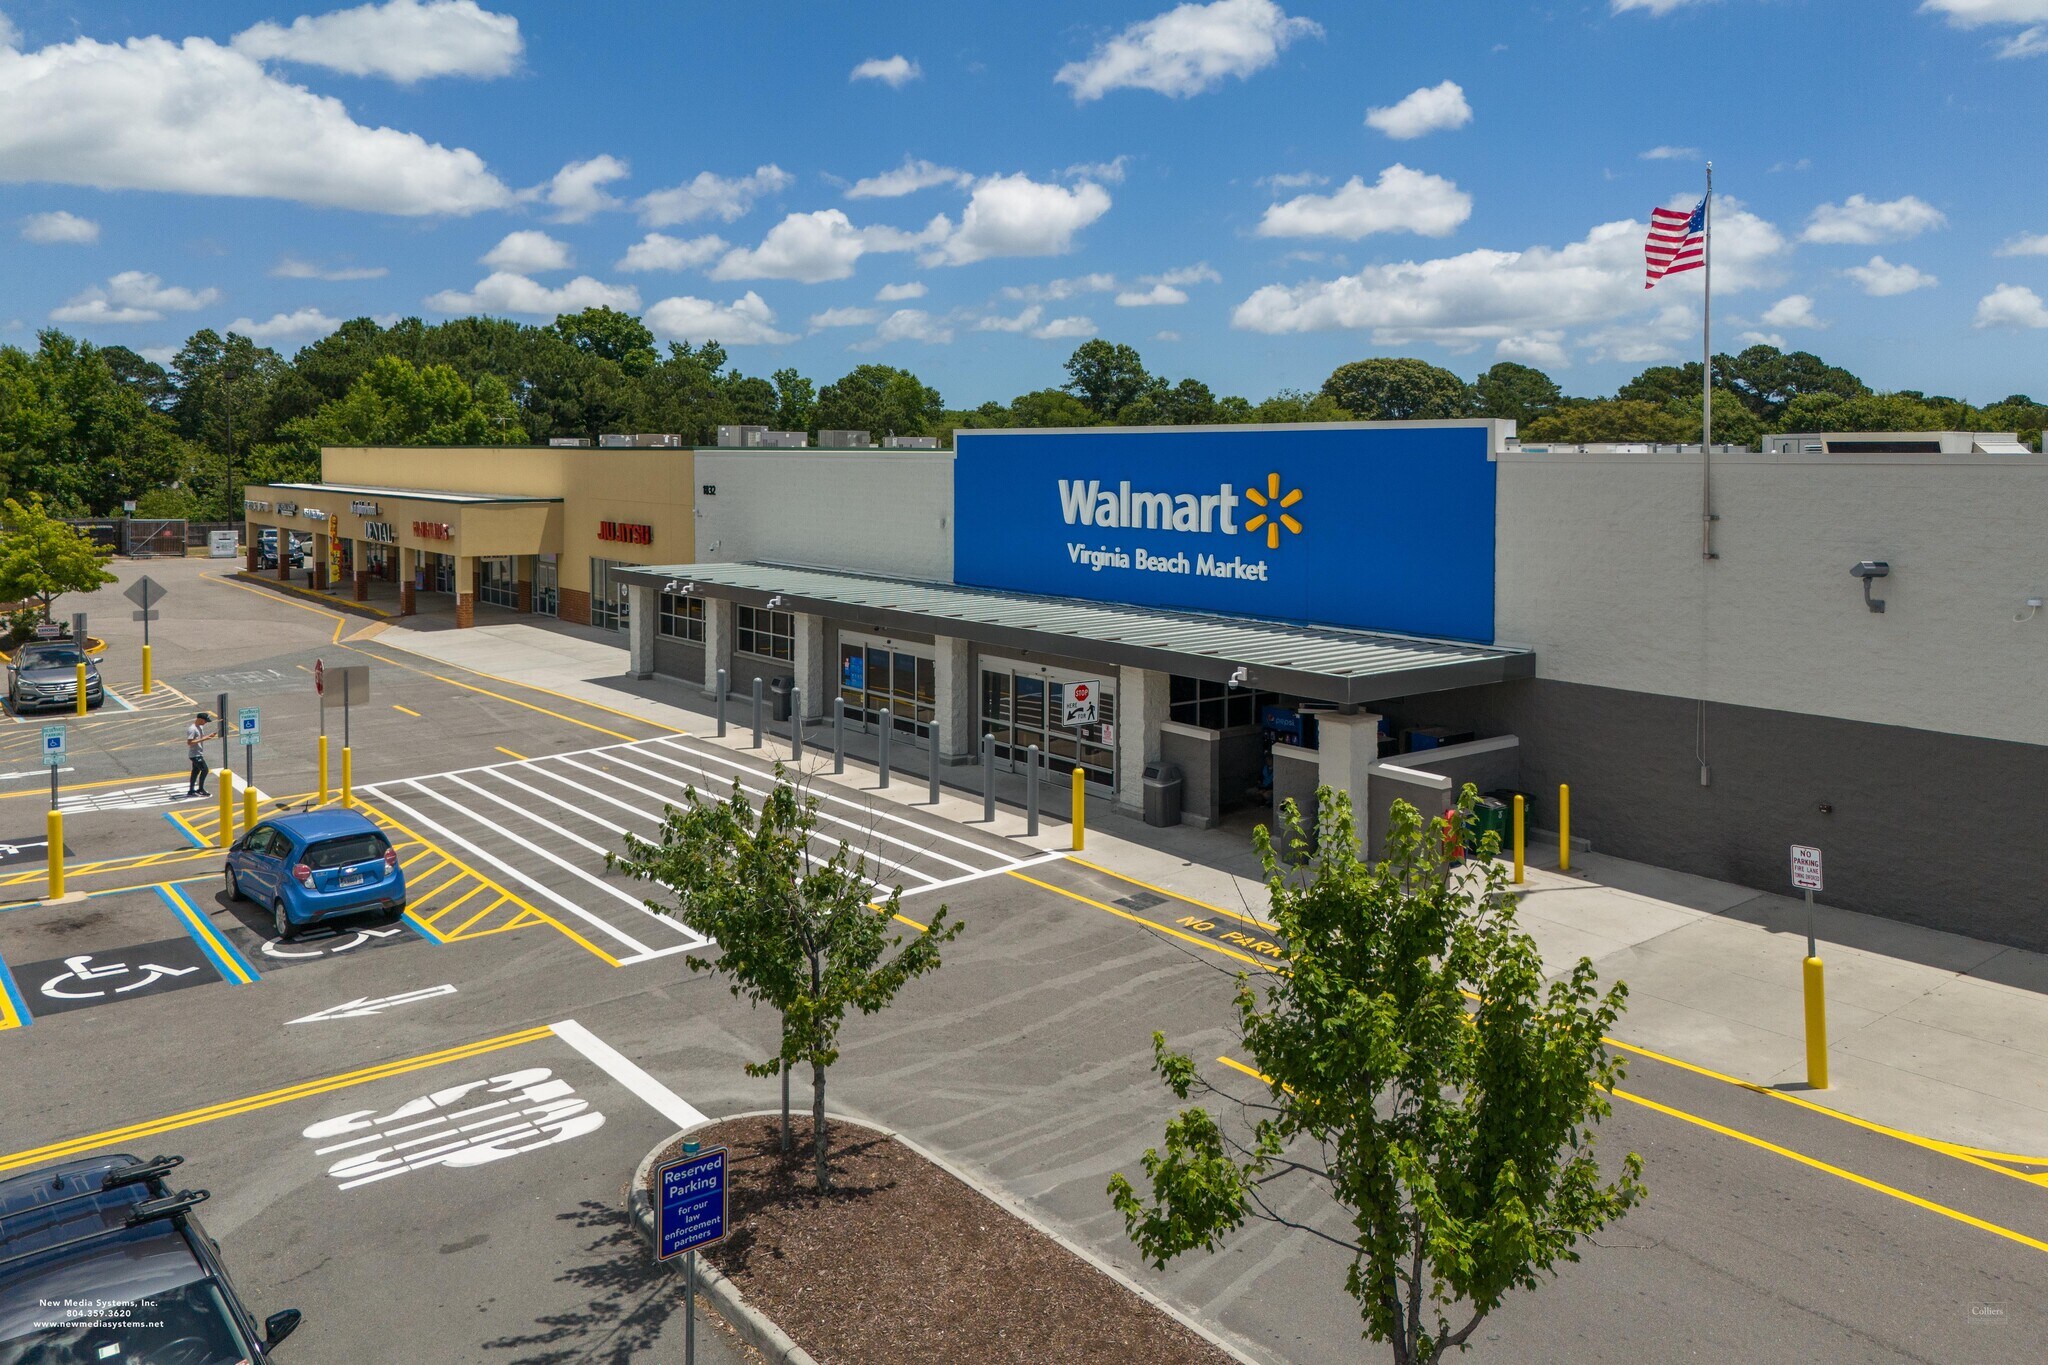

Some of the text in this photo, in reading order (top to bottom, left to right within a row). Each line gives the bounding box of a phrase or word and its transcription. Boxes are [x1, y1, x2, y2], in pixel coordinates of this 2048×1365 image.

[702, 485, 716, 496] 1832
[1058, 479, 1239, 535] Walmart
[364, 520, 394, 544] DENTAL
[597, 520, 652, 545] JIU JITSU
[1067, 543, 1268, 582] Virginia Beach Market
[1275, 718, 1295, 726] pepsi
[1793, 857, 1819, 868] PARKING
[1800, 850, 1812, 858] NO
[1794, 864, 1819, 875] FIRE LANE
[1176, 915, 1284, 958] NO PARK
[664, 1156, 722, 1184] Reserved
[669, 1175, 717, 1198] Parking
[678, 1200, 708, 1216] for our
[685, 1213, 701, 1224] law
[664, 1215, 721, 1241] enforcement
[674, 1229, 711, 1250] partners
